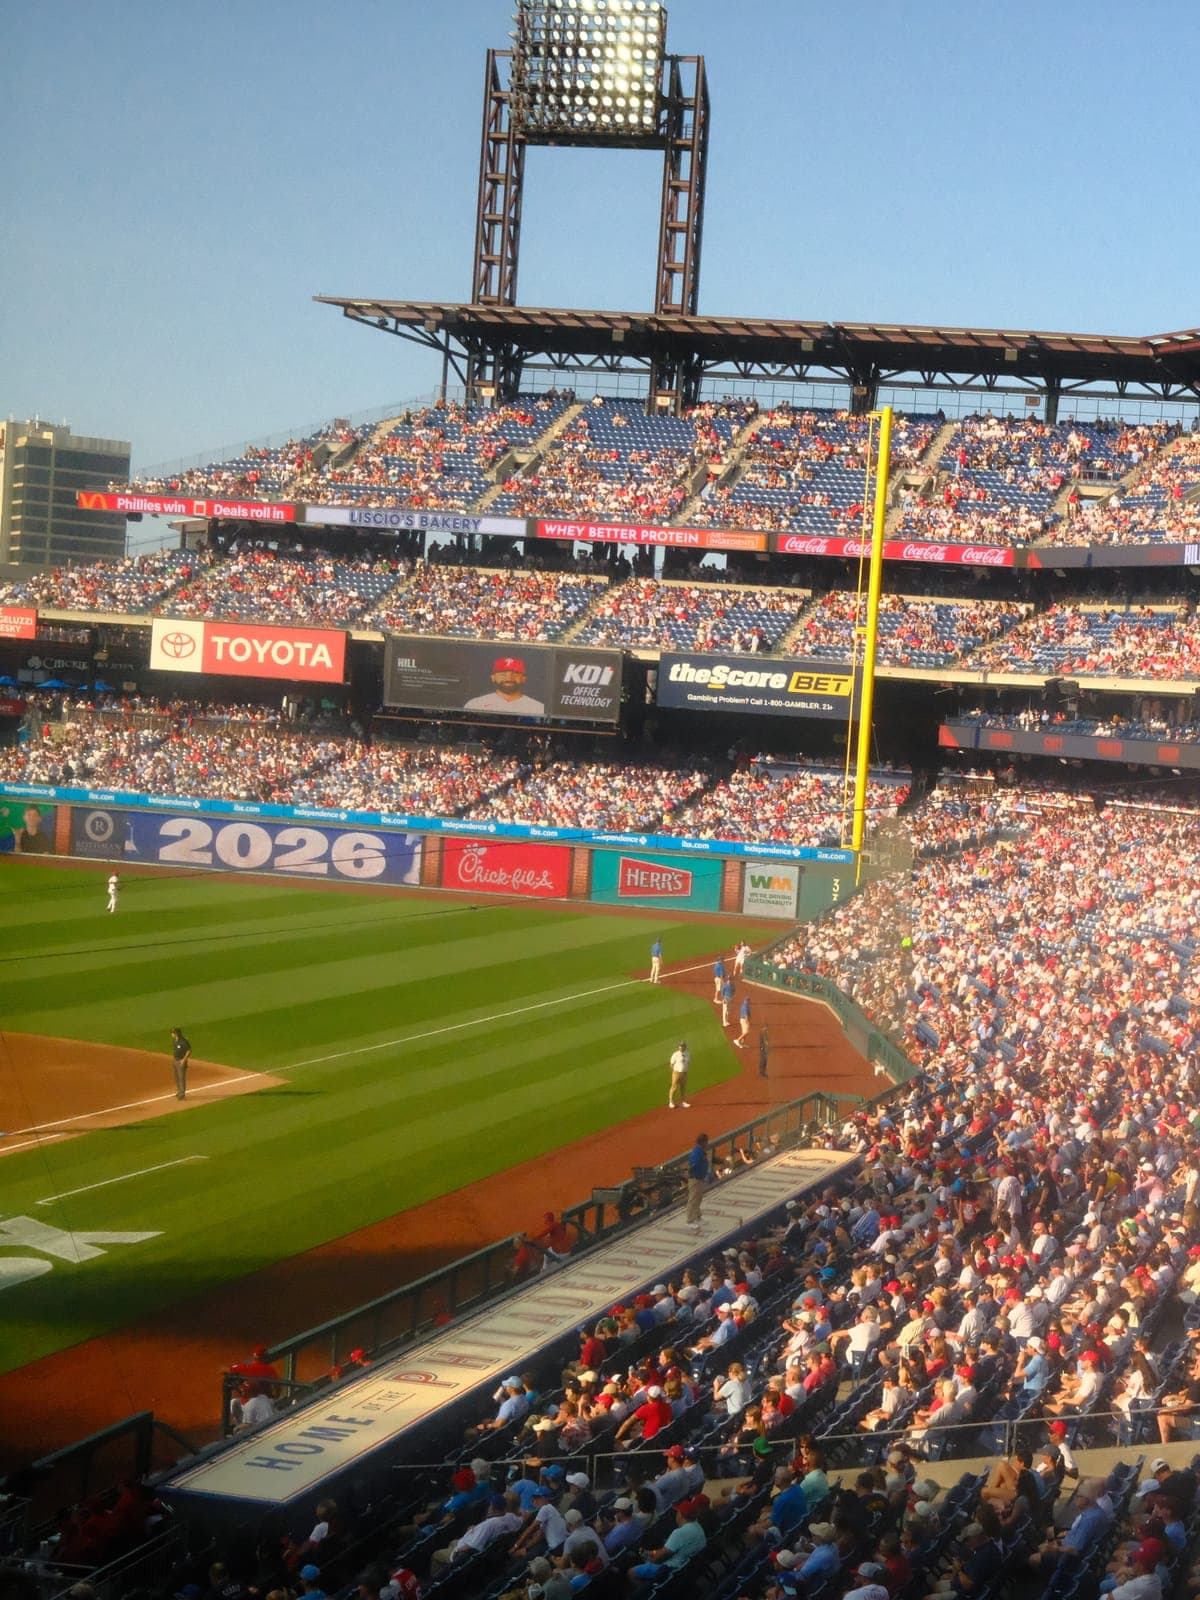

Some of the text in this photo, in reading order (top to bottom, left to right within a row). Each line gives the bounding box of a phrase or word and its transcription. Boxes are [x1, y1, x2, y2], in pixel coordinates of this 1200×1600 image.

[116, 497, 285, 519] Phillies win Deals roll in
[350, 510, 482, 530] LISCIO'S BAKERY
[544, 523, 699, 544] WHEY BETTER PROTEIN
[785, 536, 830, 554] Coca-Cola
[903, 543, 949, 561] Coca-Cola
[961, 547, 1008, 565] Coca-Cola
[211, 635, 333, 669] TOYOTA
[397, 657, 417, 668] HILL
[563, 663, 616, 686] KDI
[668, 663, 849, 693] theScore BET
[572, 686, 601, 697] OFFICE
[687, 693, 718, 704] Gambling
[718, 695, 749, 705] Problem?
[750, 698, 763, 706] Call
[560, 695, 613, 709] TECHNOLOGY
[4, 785, 49, 796] Independence
[148, 796, 192, 808] Independence
[293, 808, 339, 819] Independence
[441, 821, 488, 832] Independence
[159, 817, 387, 879] 2026
[744, 845, 792, 856] Independence
[458, 851, 554, 890] Chick-fil-A
[626, 868, 684, 892] HERR'S
[750, 874, 793, 891] WM
[747, 897, 793, 906] SUSTAINABILITY
[362, 1390, 409, 1411] OF THE
[244, 1413, 376, 1472] HOME
